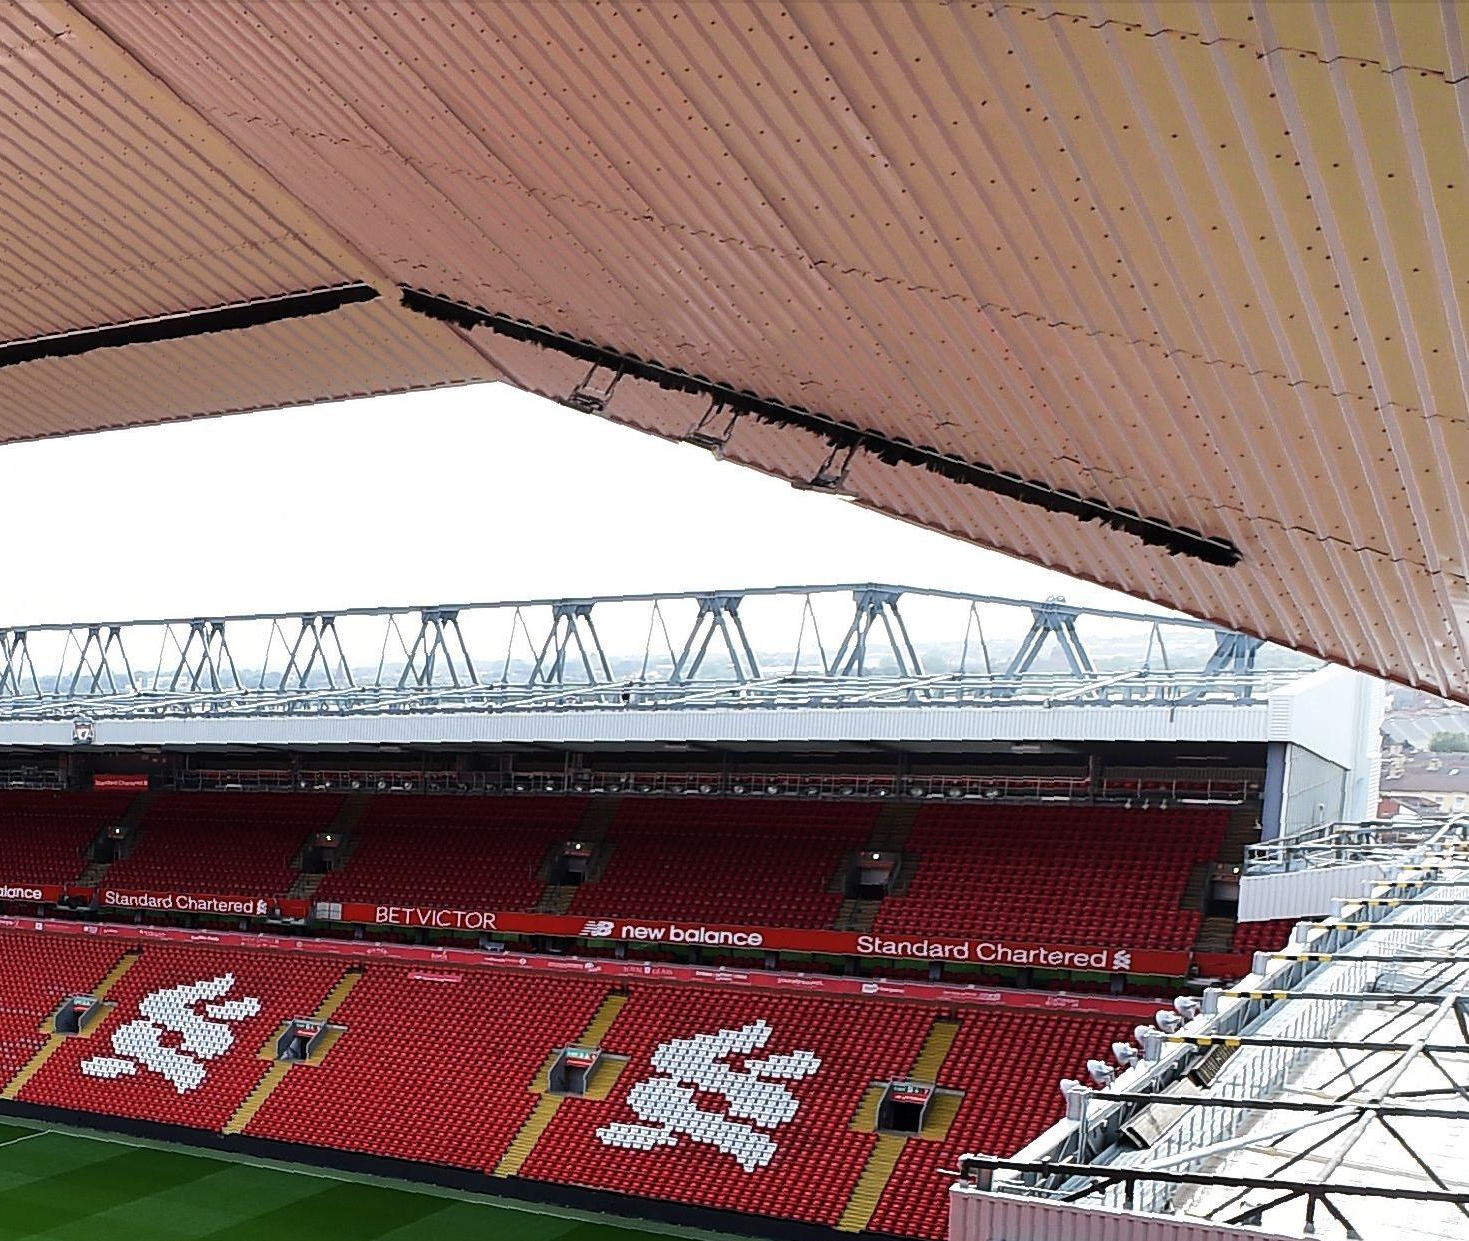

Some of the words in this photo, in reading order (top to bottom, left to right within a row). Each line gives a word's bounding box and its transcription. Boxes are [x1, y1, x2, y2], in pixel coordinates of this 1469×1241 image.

[104, 889, 173, 911] Standard
[175, 894, 254, 915] Chartered
[375, 905, 498, 931] BETVICTOR
[620, 923, 667, 941] new
[668, 924, 764, 947] balance
[856, 934, 970, 960] Standard
[975, 941, 1109, 969] Chartered
